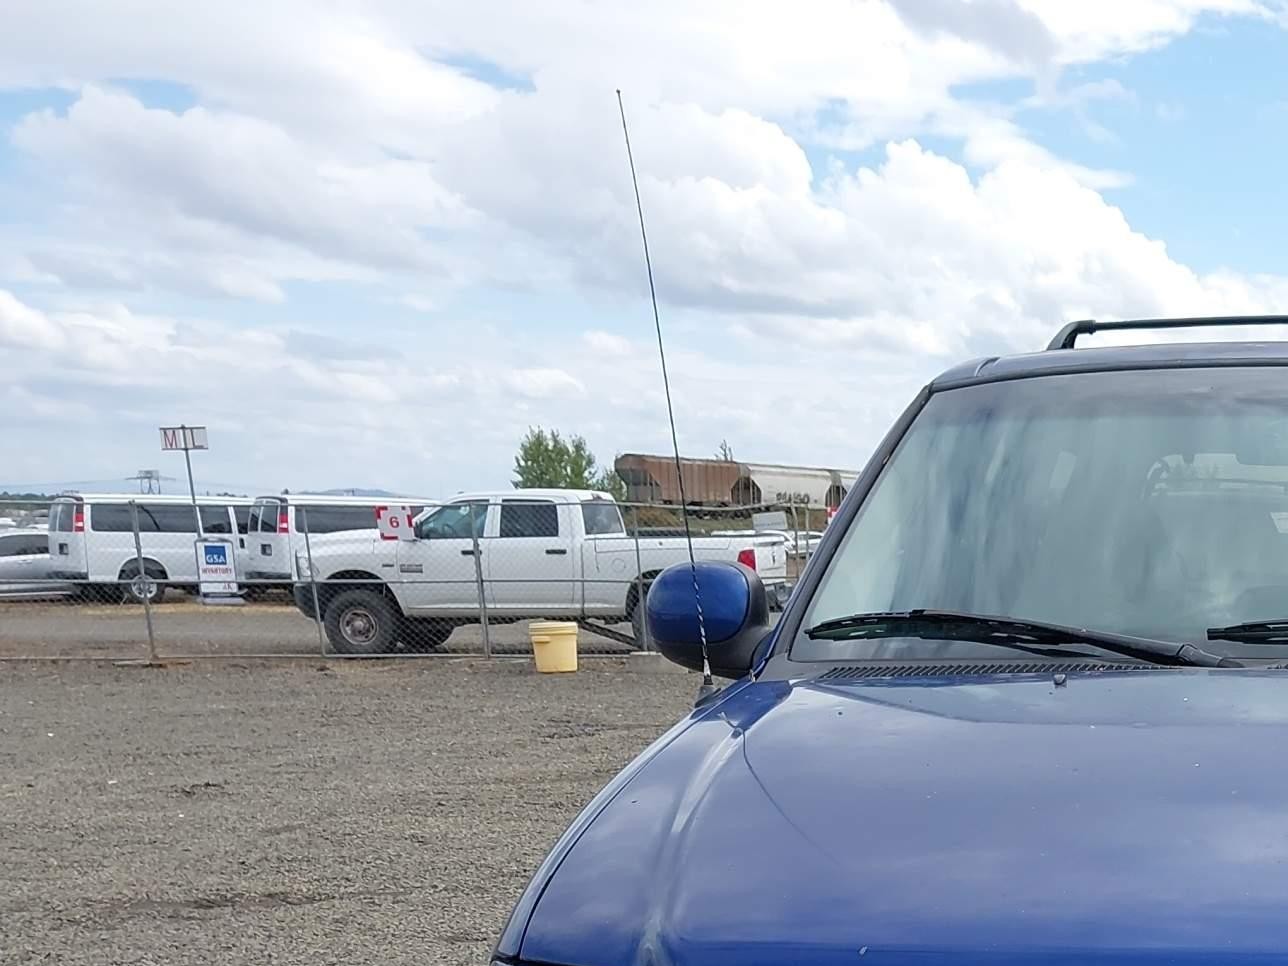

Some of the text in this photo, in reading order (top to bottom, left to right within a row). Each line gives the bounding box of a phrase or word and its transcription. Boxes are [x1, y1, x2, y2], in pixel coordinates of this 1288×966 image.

[163, 430, 178, 449] M
[389, 516, 400, 529] 6
[206, 554, 226, 564] GSA
